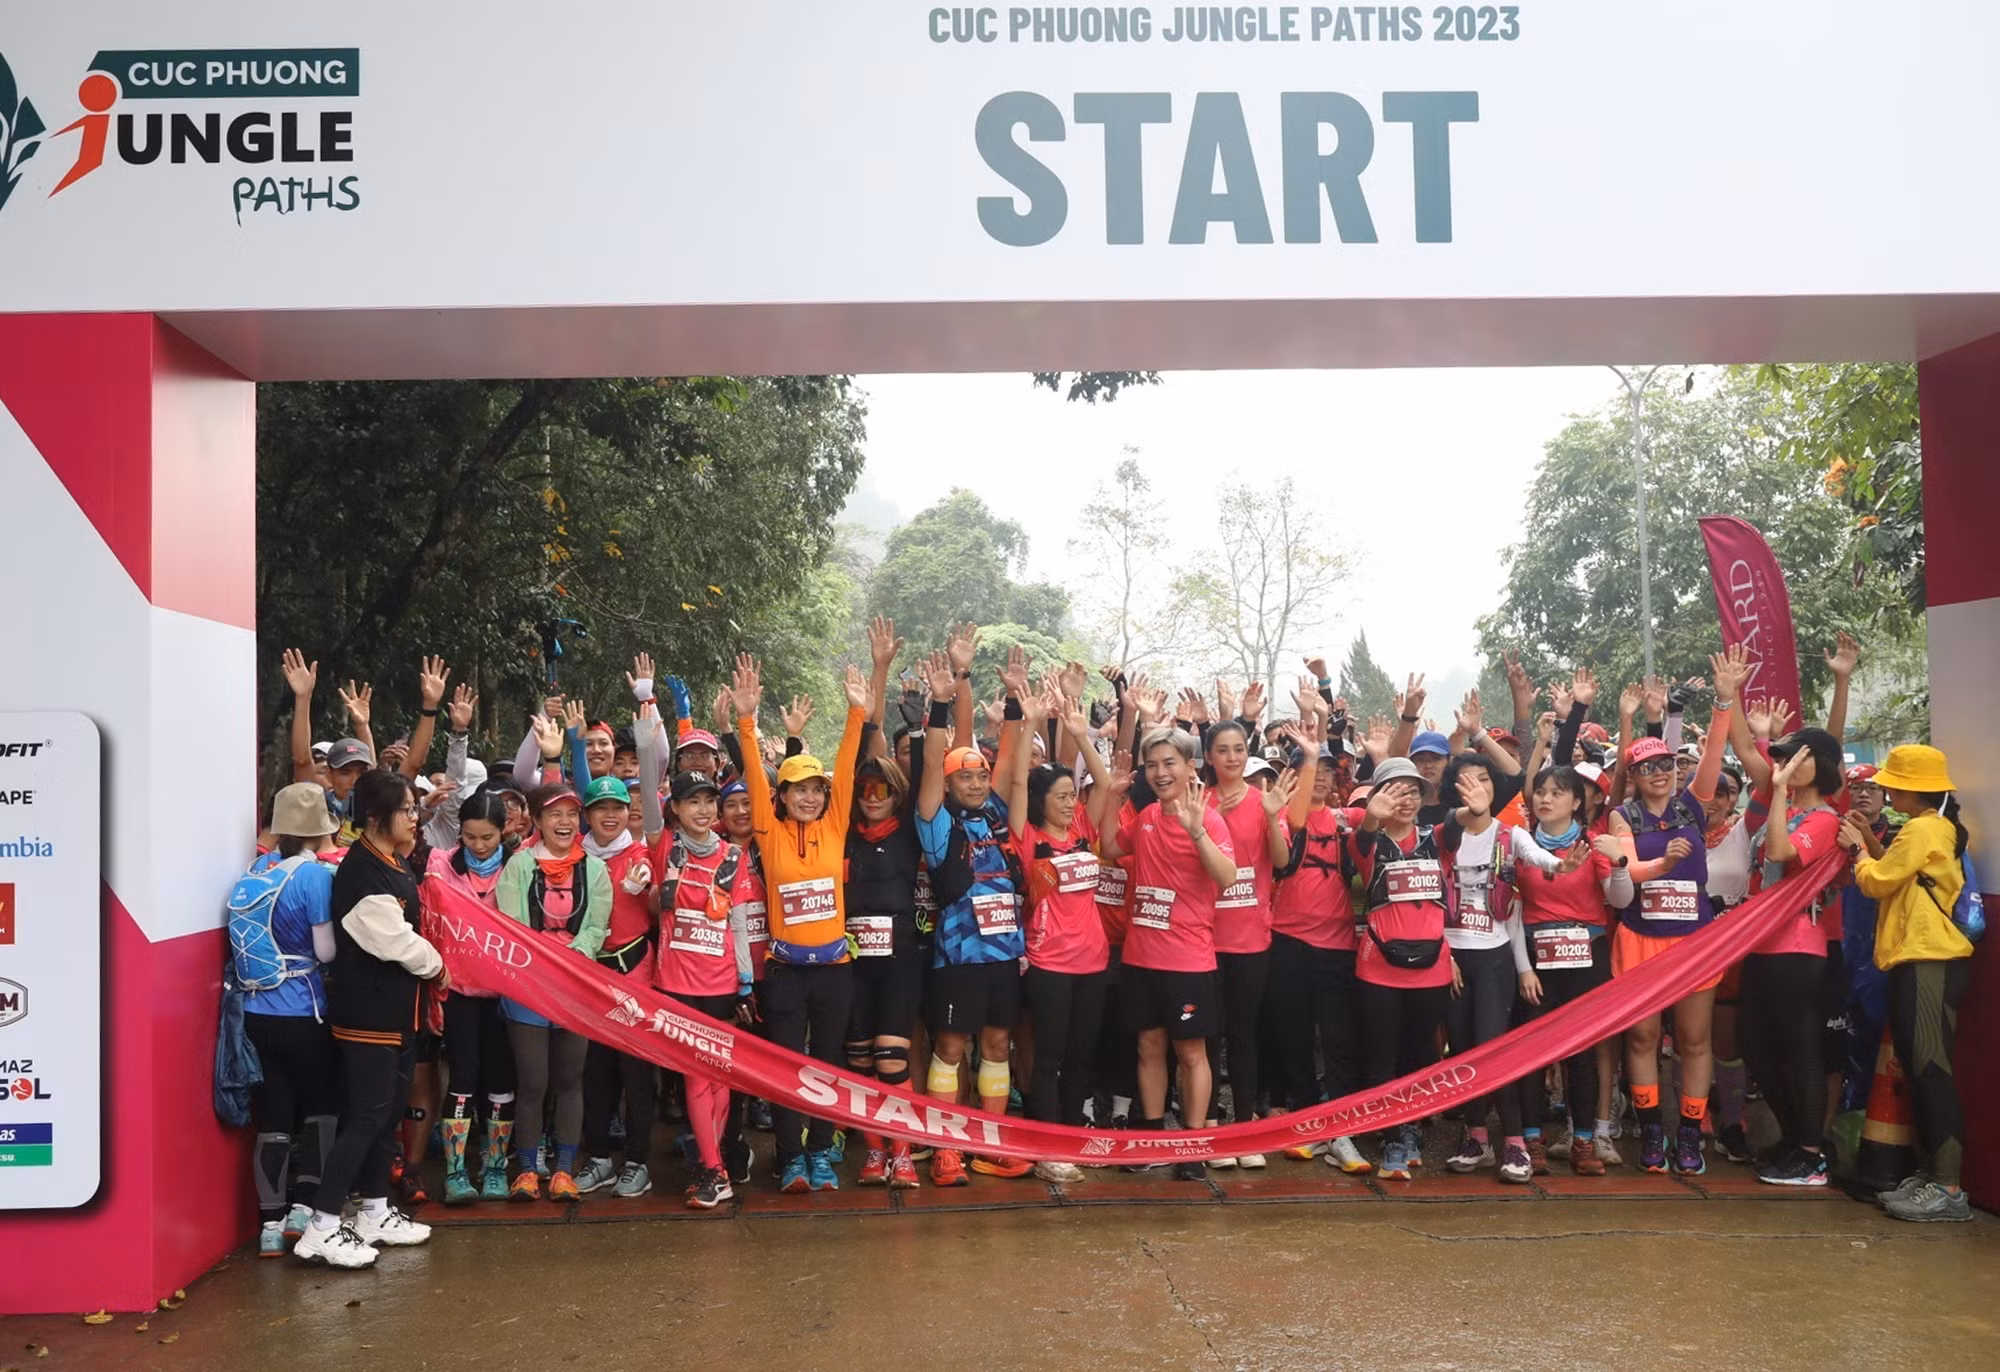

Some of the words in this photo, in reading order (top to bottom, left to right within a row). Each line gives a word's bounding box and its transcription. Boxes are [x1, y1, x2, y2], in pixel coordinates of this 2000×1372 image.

[928, 6, 998, 43] CUC
[1009, 5, 1151, 42] PHUONG
[1162, 5, 1300, 42] JUNGLE
[1311, 5, 1423, 41] PATHS
[1433, 5, 1520, 41] 2023
[128, 61, 197, 86] CUC
[206, 60, 347, 86] PHUONG
[975, 91, 1479, 247] START
[233, 176, 360, 227] PATHS
[0, 743, 43, 757] FIT
[1633, 740, 1664, 756] ciele
[1098, 881, 1124, 895] 20681
[1223, 882, 1253, 896] 20105
[1408, 875, 1438, 888] 20102
[1141, 902, 1170, 918] 20095
[1661, 896, 1695, 908] 20258
[1461, 912, 1489, 927] 20101
[689, 927, 724, 944] 20383
[858, 932, 890, 944] 20628
[1554, 944, 1589, 957] 20202
[668, 1014, 688, 1028] CUC
[689, 1021, 731, 1044] PHUONG
[695, 1052, 733, 1073] PATHS
[1332, 1064, 1477, 1124] MENARD
[796, 1065, 1013, 1145] START
[1174, 1147, 1215, 1156] PATHS
